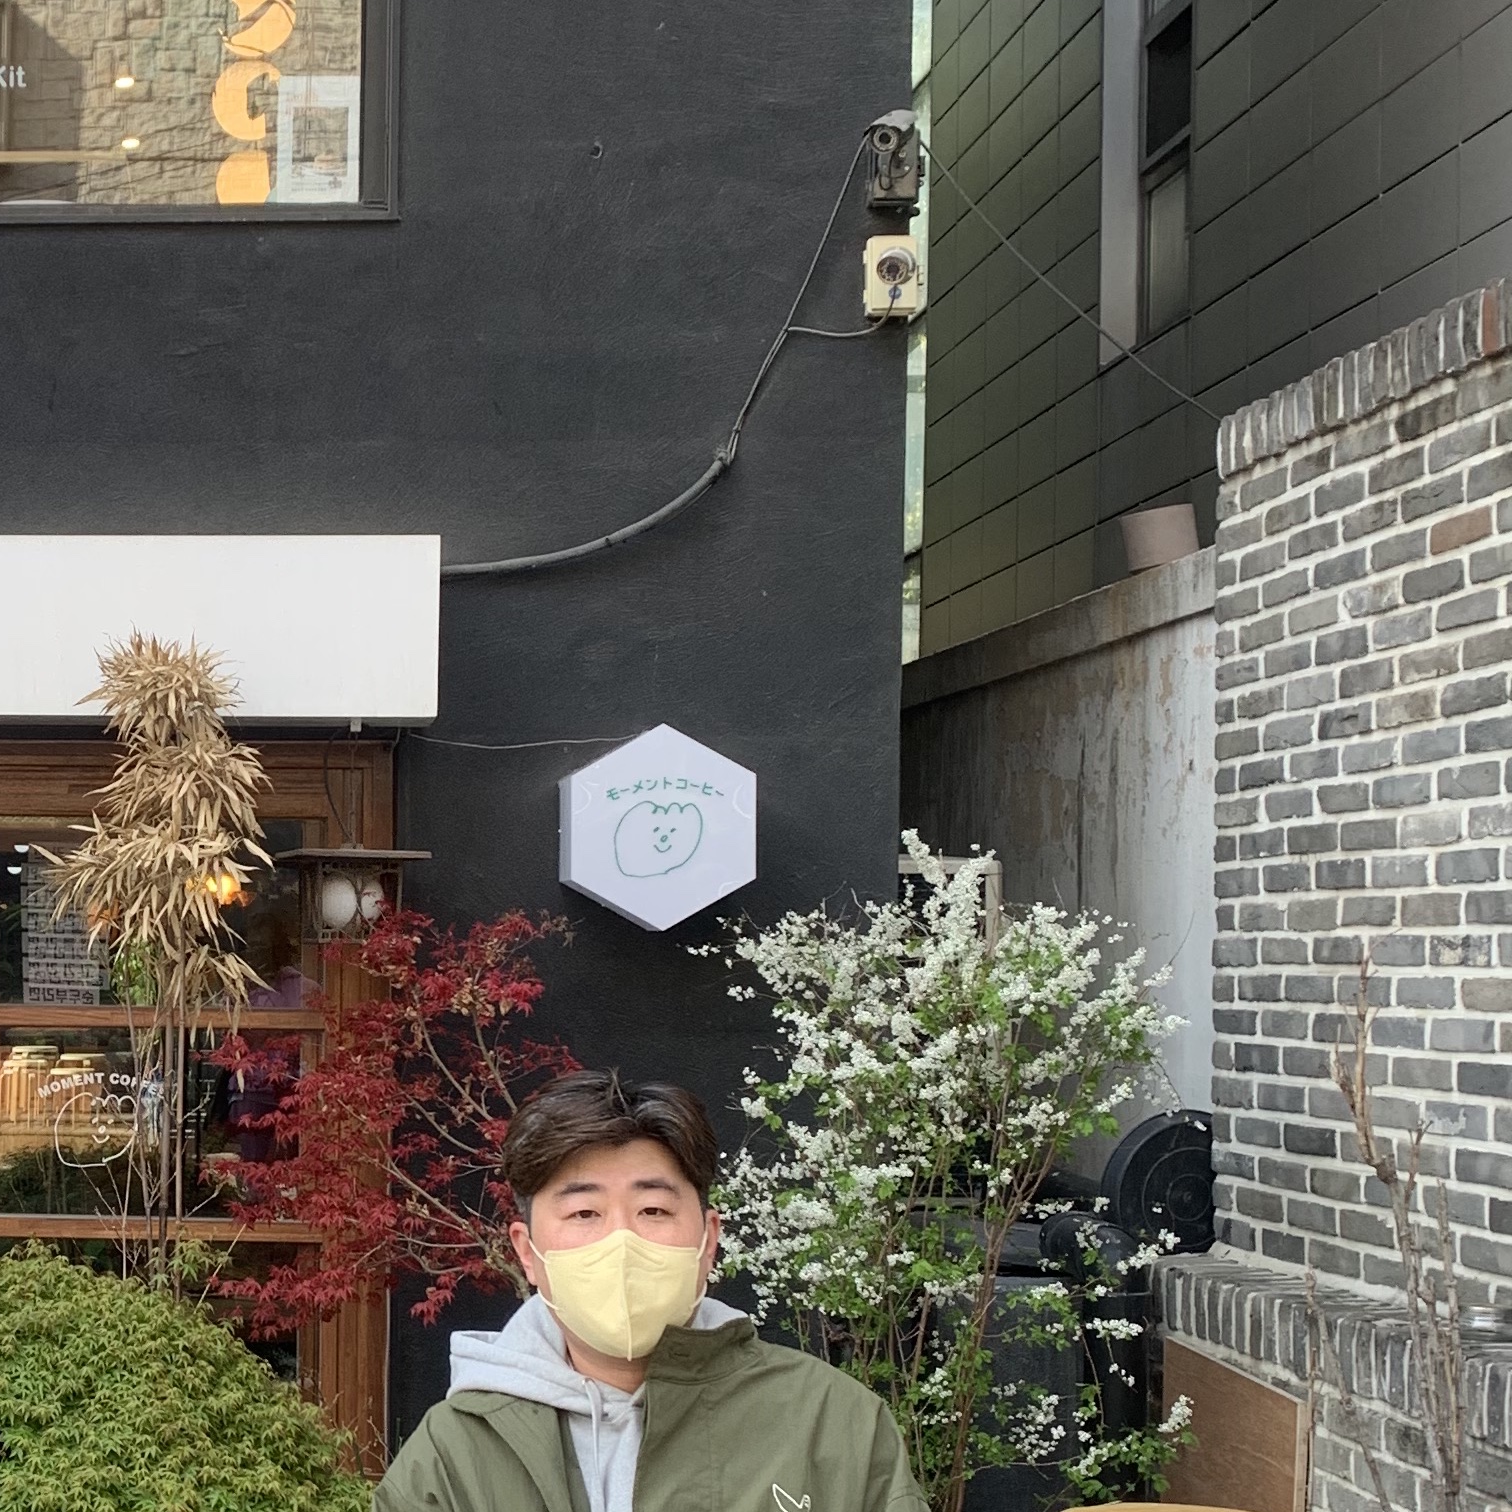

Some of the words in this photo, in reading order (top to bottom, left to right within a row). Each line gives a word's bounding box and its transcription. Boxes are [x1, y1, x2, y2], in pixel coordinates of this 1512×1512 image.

[606, 776, 724, 800] モーメントコーヒー
[37, 1072, 105, 1099] MOMENT
